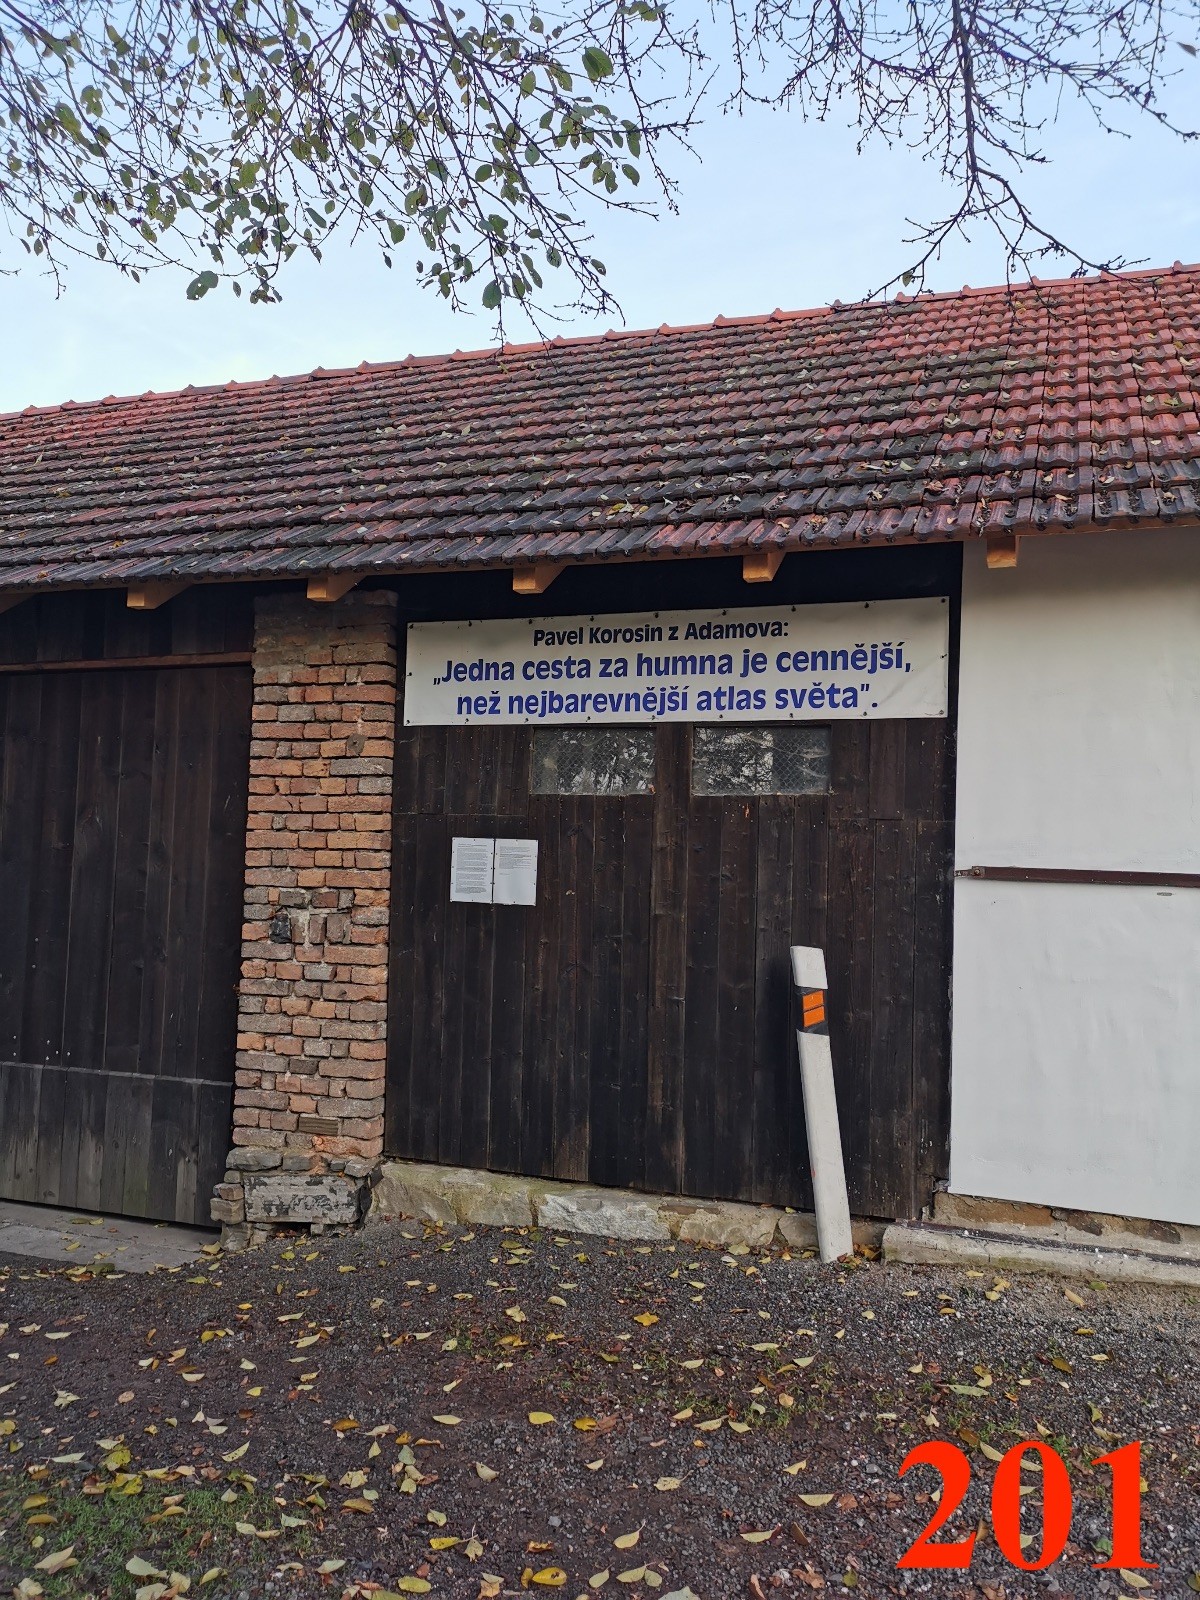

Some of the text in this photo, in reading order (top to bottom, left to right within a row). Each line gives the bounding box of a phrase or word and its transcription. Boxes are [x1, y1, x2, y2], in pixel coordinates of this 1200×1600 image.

[533, 620, 789, 647] Pavel Korosin z Adamova:
[521, 656, 592, 681] cesta
[598, 656, 629, 679] za
[635, 651, 733, 678] humna
[740, 648, 768, 678] je
[775, 641, 912, 674] cennější,
[456, 688, 501, 715] než
[508, 685, 689, 718] nejbarevnější
[696, 685, 767, 712] atlas
